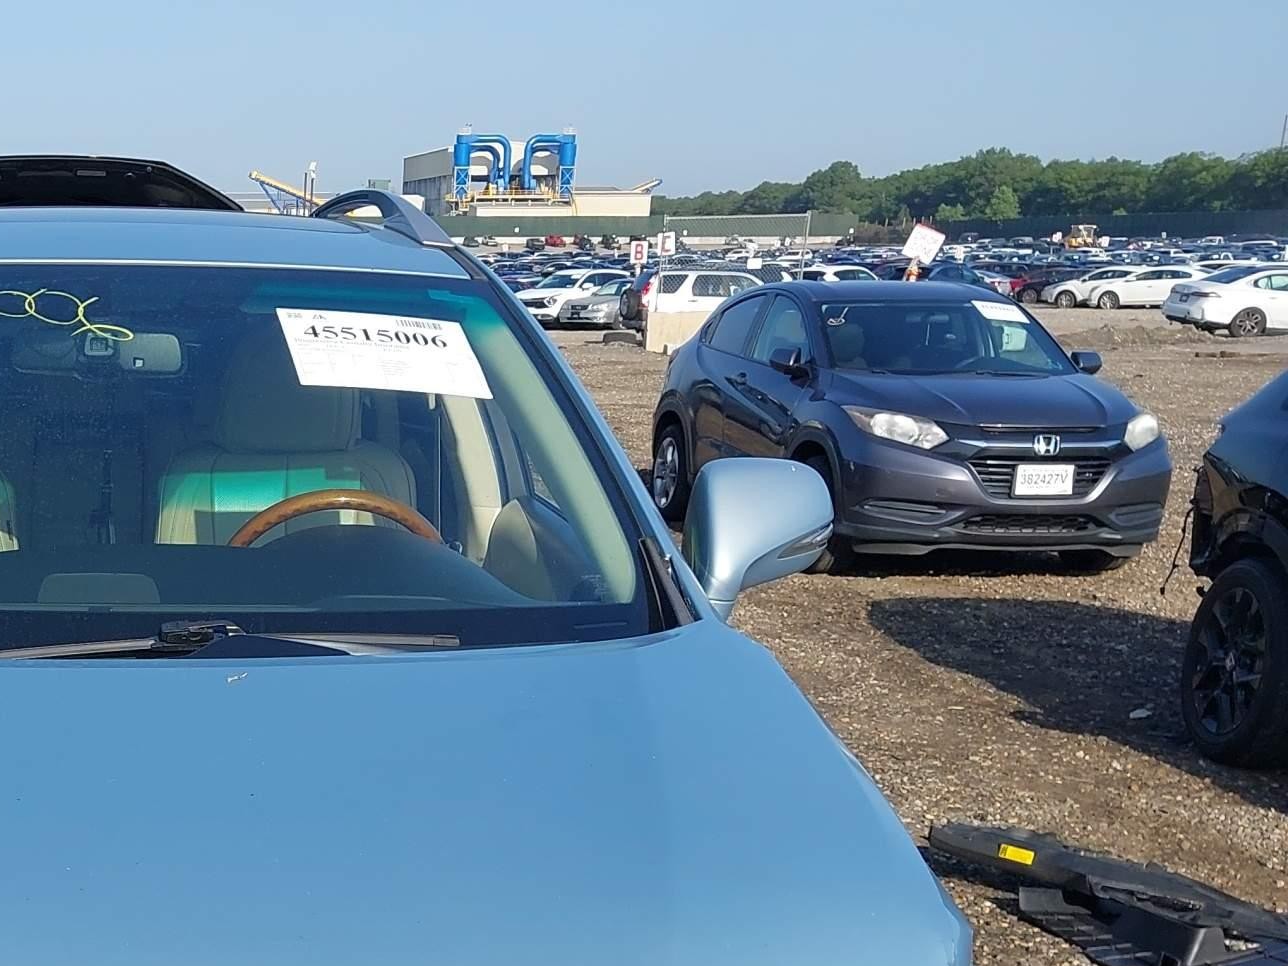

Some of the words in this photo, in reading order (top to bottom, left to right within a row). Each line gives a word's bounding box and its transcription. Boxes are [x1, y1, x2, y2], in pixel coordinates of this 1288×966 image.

[634, 243, 644, 260] B
[303, 324, 448, 349] 45515006
[1020, 472, 1069, 485] 382427V
